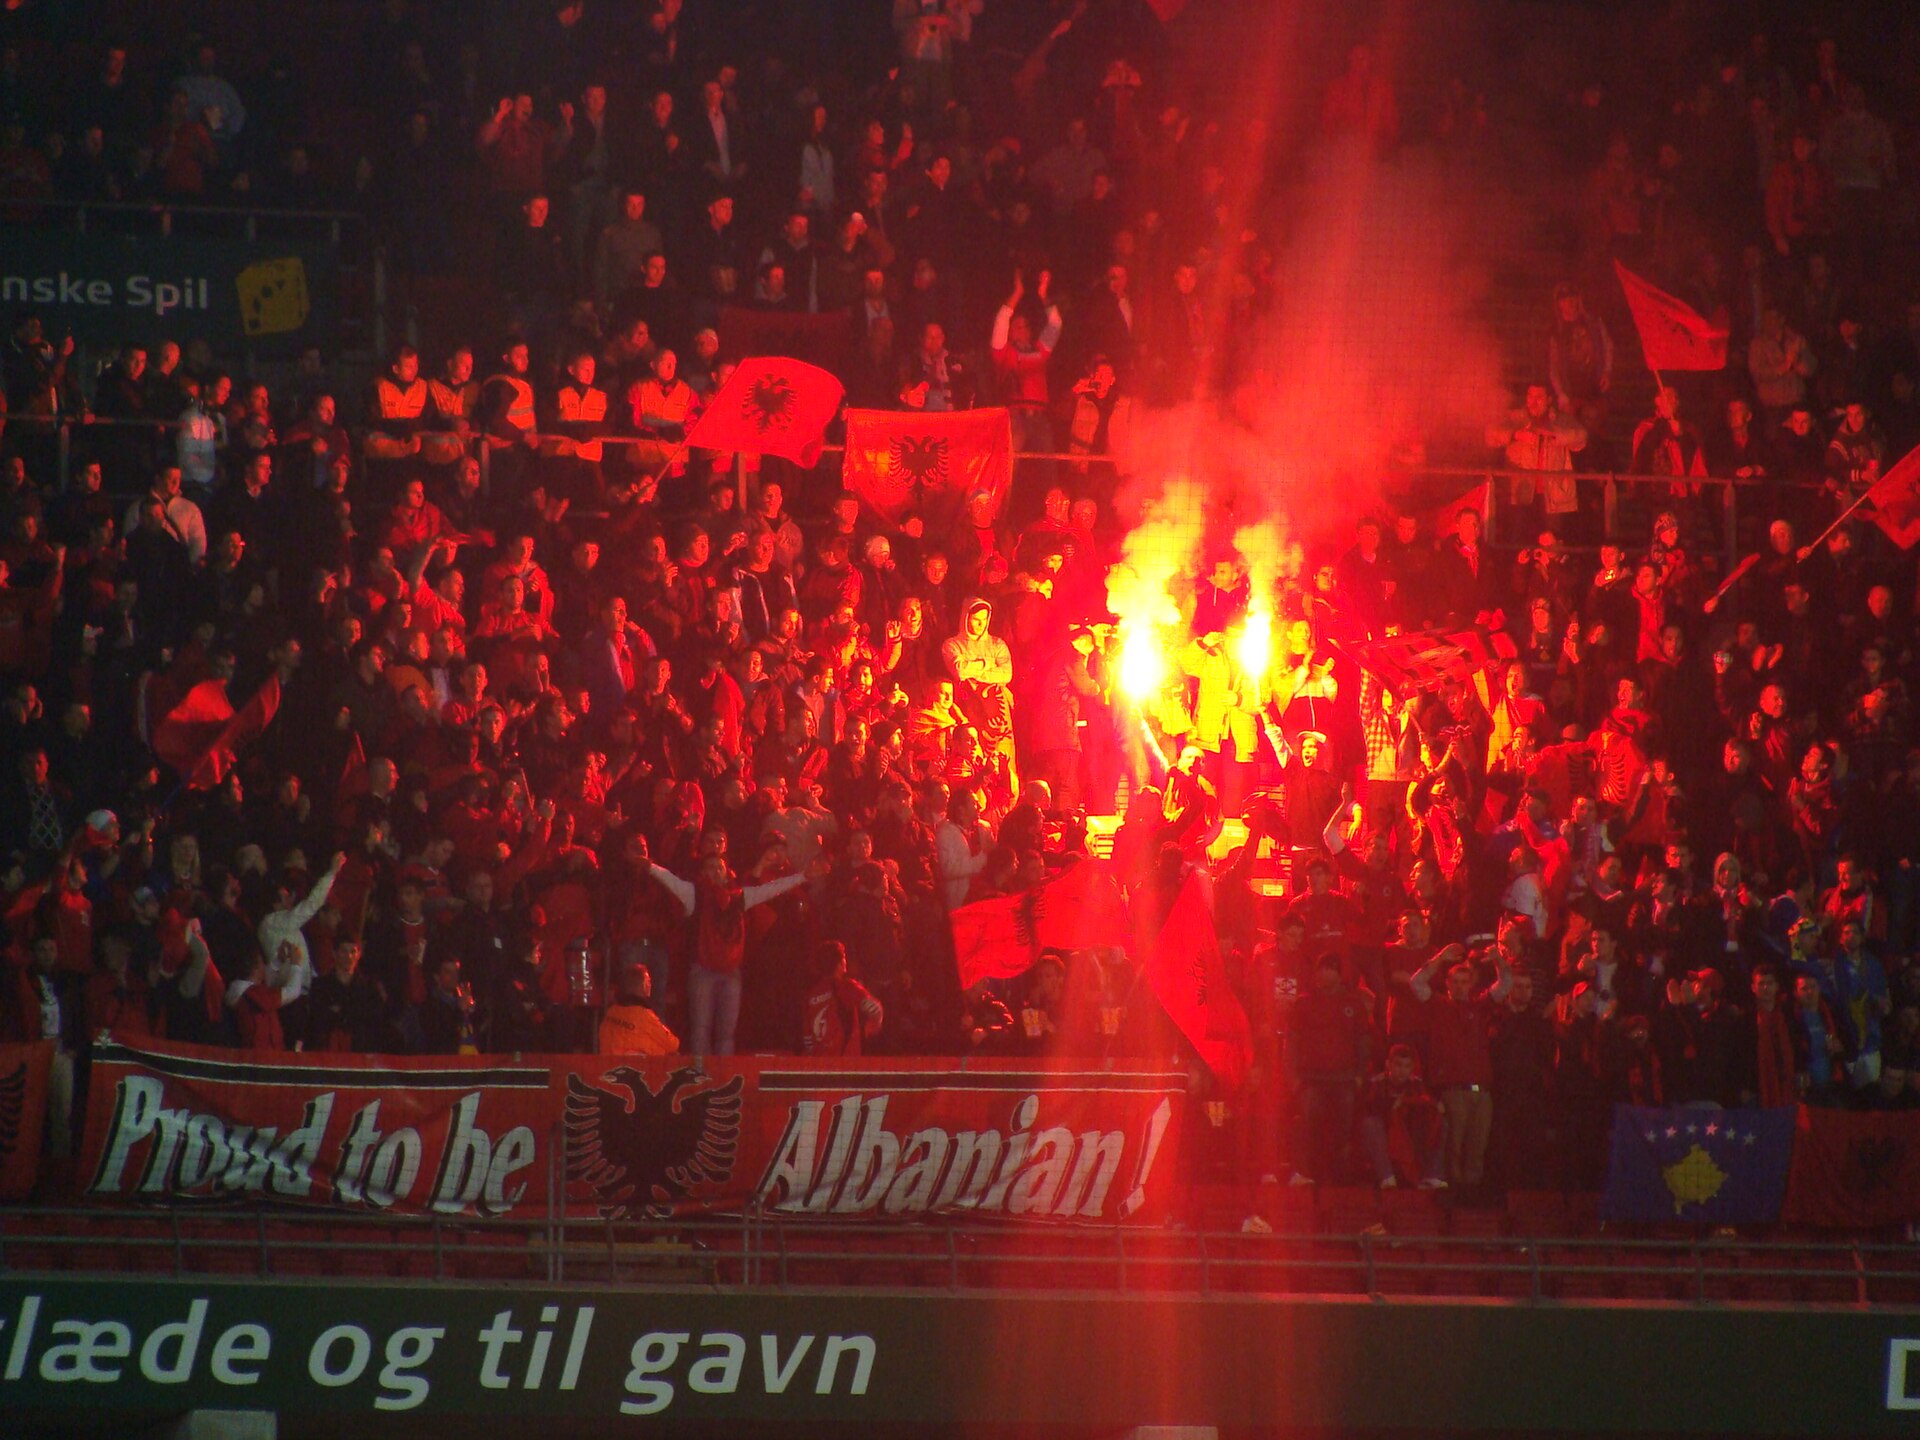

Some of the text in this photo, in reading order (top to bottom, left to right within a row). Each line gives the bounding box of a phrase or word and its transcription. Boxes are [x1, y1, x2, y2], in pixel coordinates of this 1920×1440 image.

[1, 271, 208, 316] nske Spil
[88, 1075, 335, 1197] Proud
[331, 1098, 422, 1206] to
[429, 1091, 535, 1217] be
[0, 1296, 877, 1415] læde og til gavn
